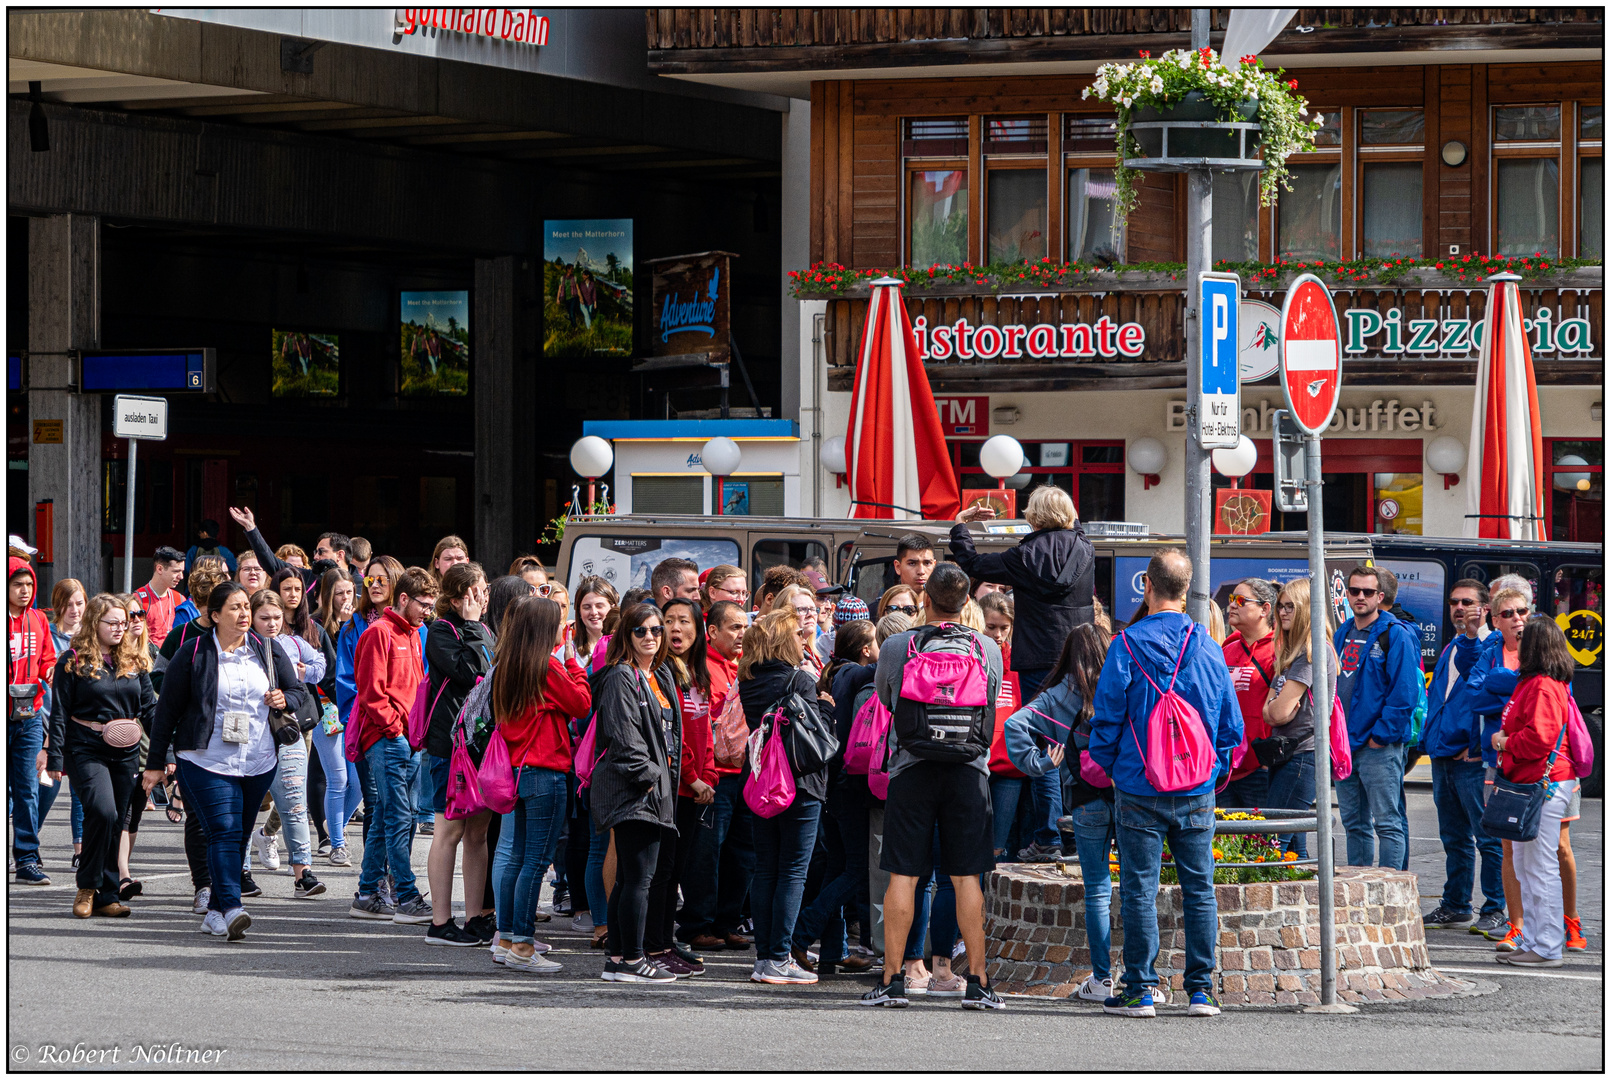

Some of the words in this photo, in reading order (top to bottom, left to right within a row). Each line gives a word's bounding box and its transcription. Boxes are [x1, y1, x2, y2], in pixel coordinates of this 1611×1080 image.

[501, 9, 550, 46] bahn
[585, 230, 625, 238] Matterhorn
[660, 290, 715, 334] Adventure
[913, 315, 1145, 359] istorante
[1212, 293, 1228, 368] P
[1345, 307, 1594, 353] Pizzia
[192, 375, 199, 386] 6
[935, 399, 976, 424] TM
[1211, 401, 1220, 416] Nur
[1220, 401, 1228, 416] für
[124, 412, 146, 424] ausladen
[148, 412, 158, 425] Taxi
[614, 539, 647, 547] ZERMATTERS
[1395, 571, 1420, 580] avel
[1571, 629, 1596, 641] 24/7
[1421, 648, 1435, 657] att
